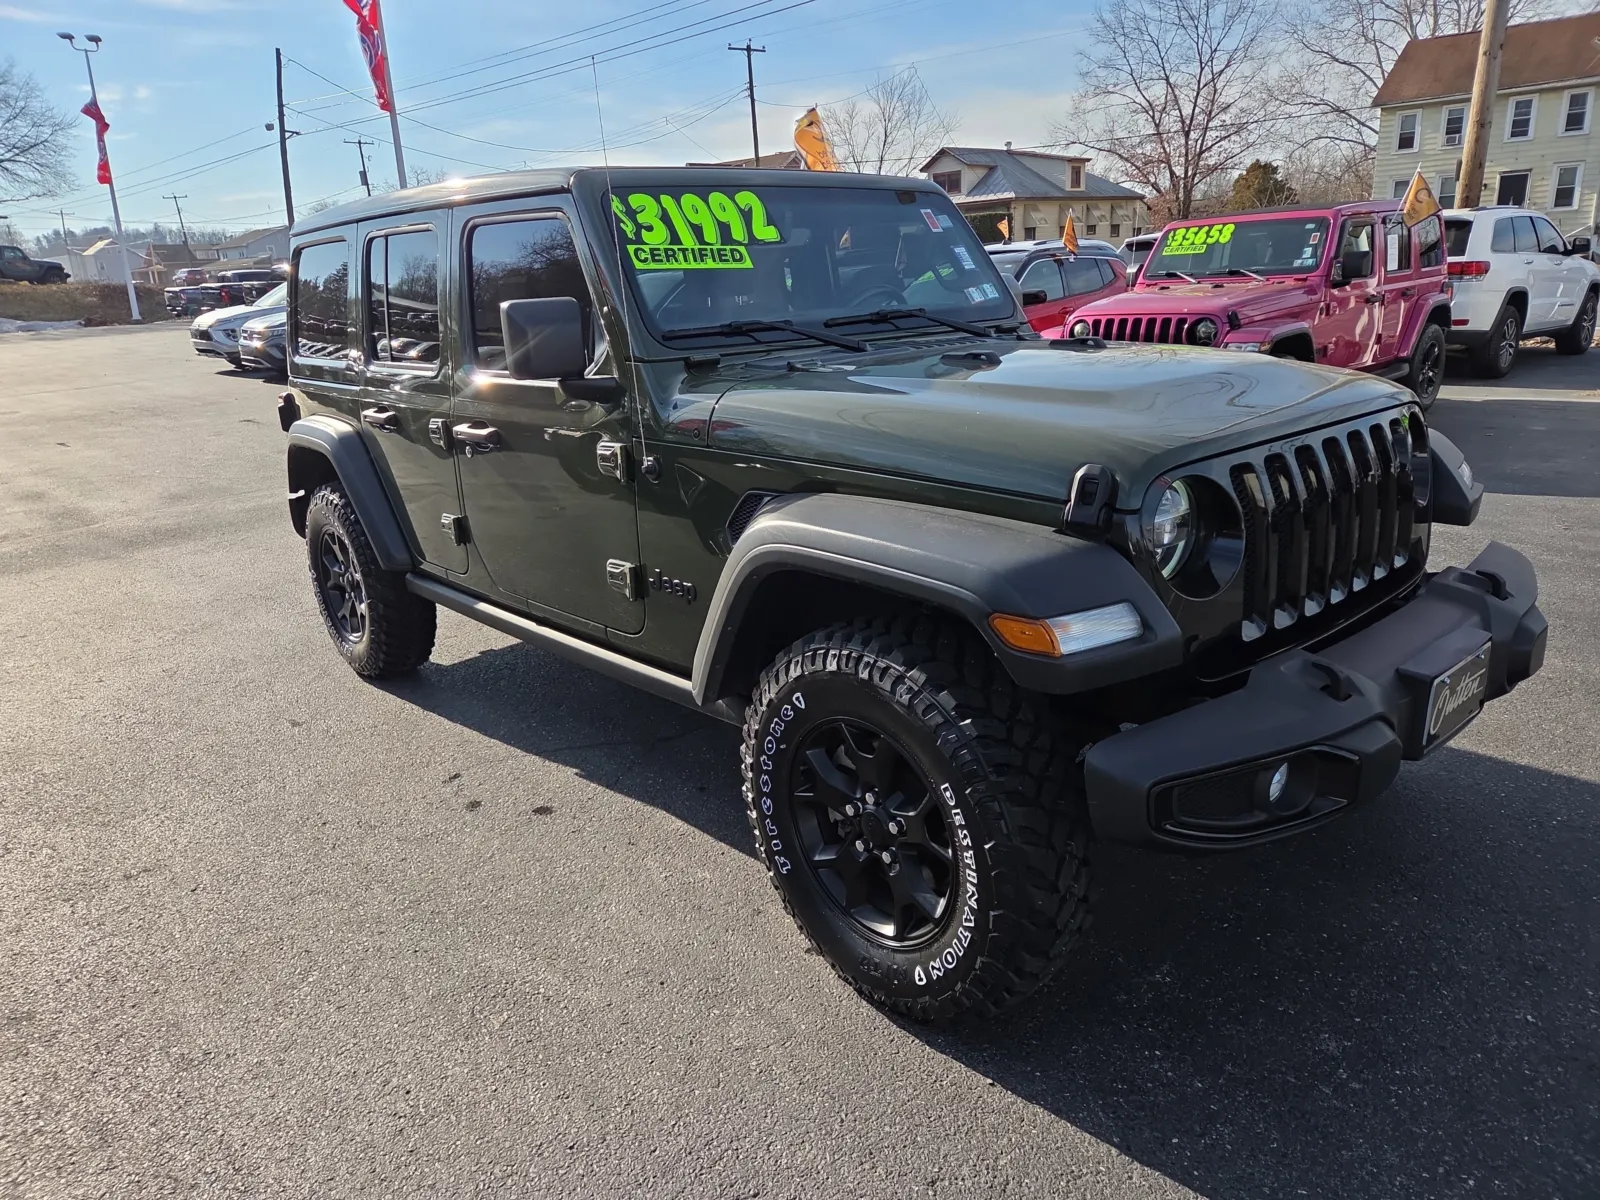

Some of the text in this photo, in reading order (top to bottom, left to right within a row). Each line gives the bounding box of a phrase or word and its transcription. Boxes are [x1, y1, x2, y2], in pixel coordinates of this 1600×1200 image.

[611, 190, 781, 246] $31992
[1167, 223, 1236, 247] $35658
[633, 247, 747, 265] CERTIFIED
[1164, 245, 1205, 253] CERTIFIED
[648, 568, 697, 605] Jeep
[760, 704, 794, 874] Firestone
[928, 782, 979, 981] DESTINATION
